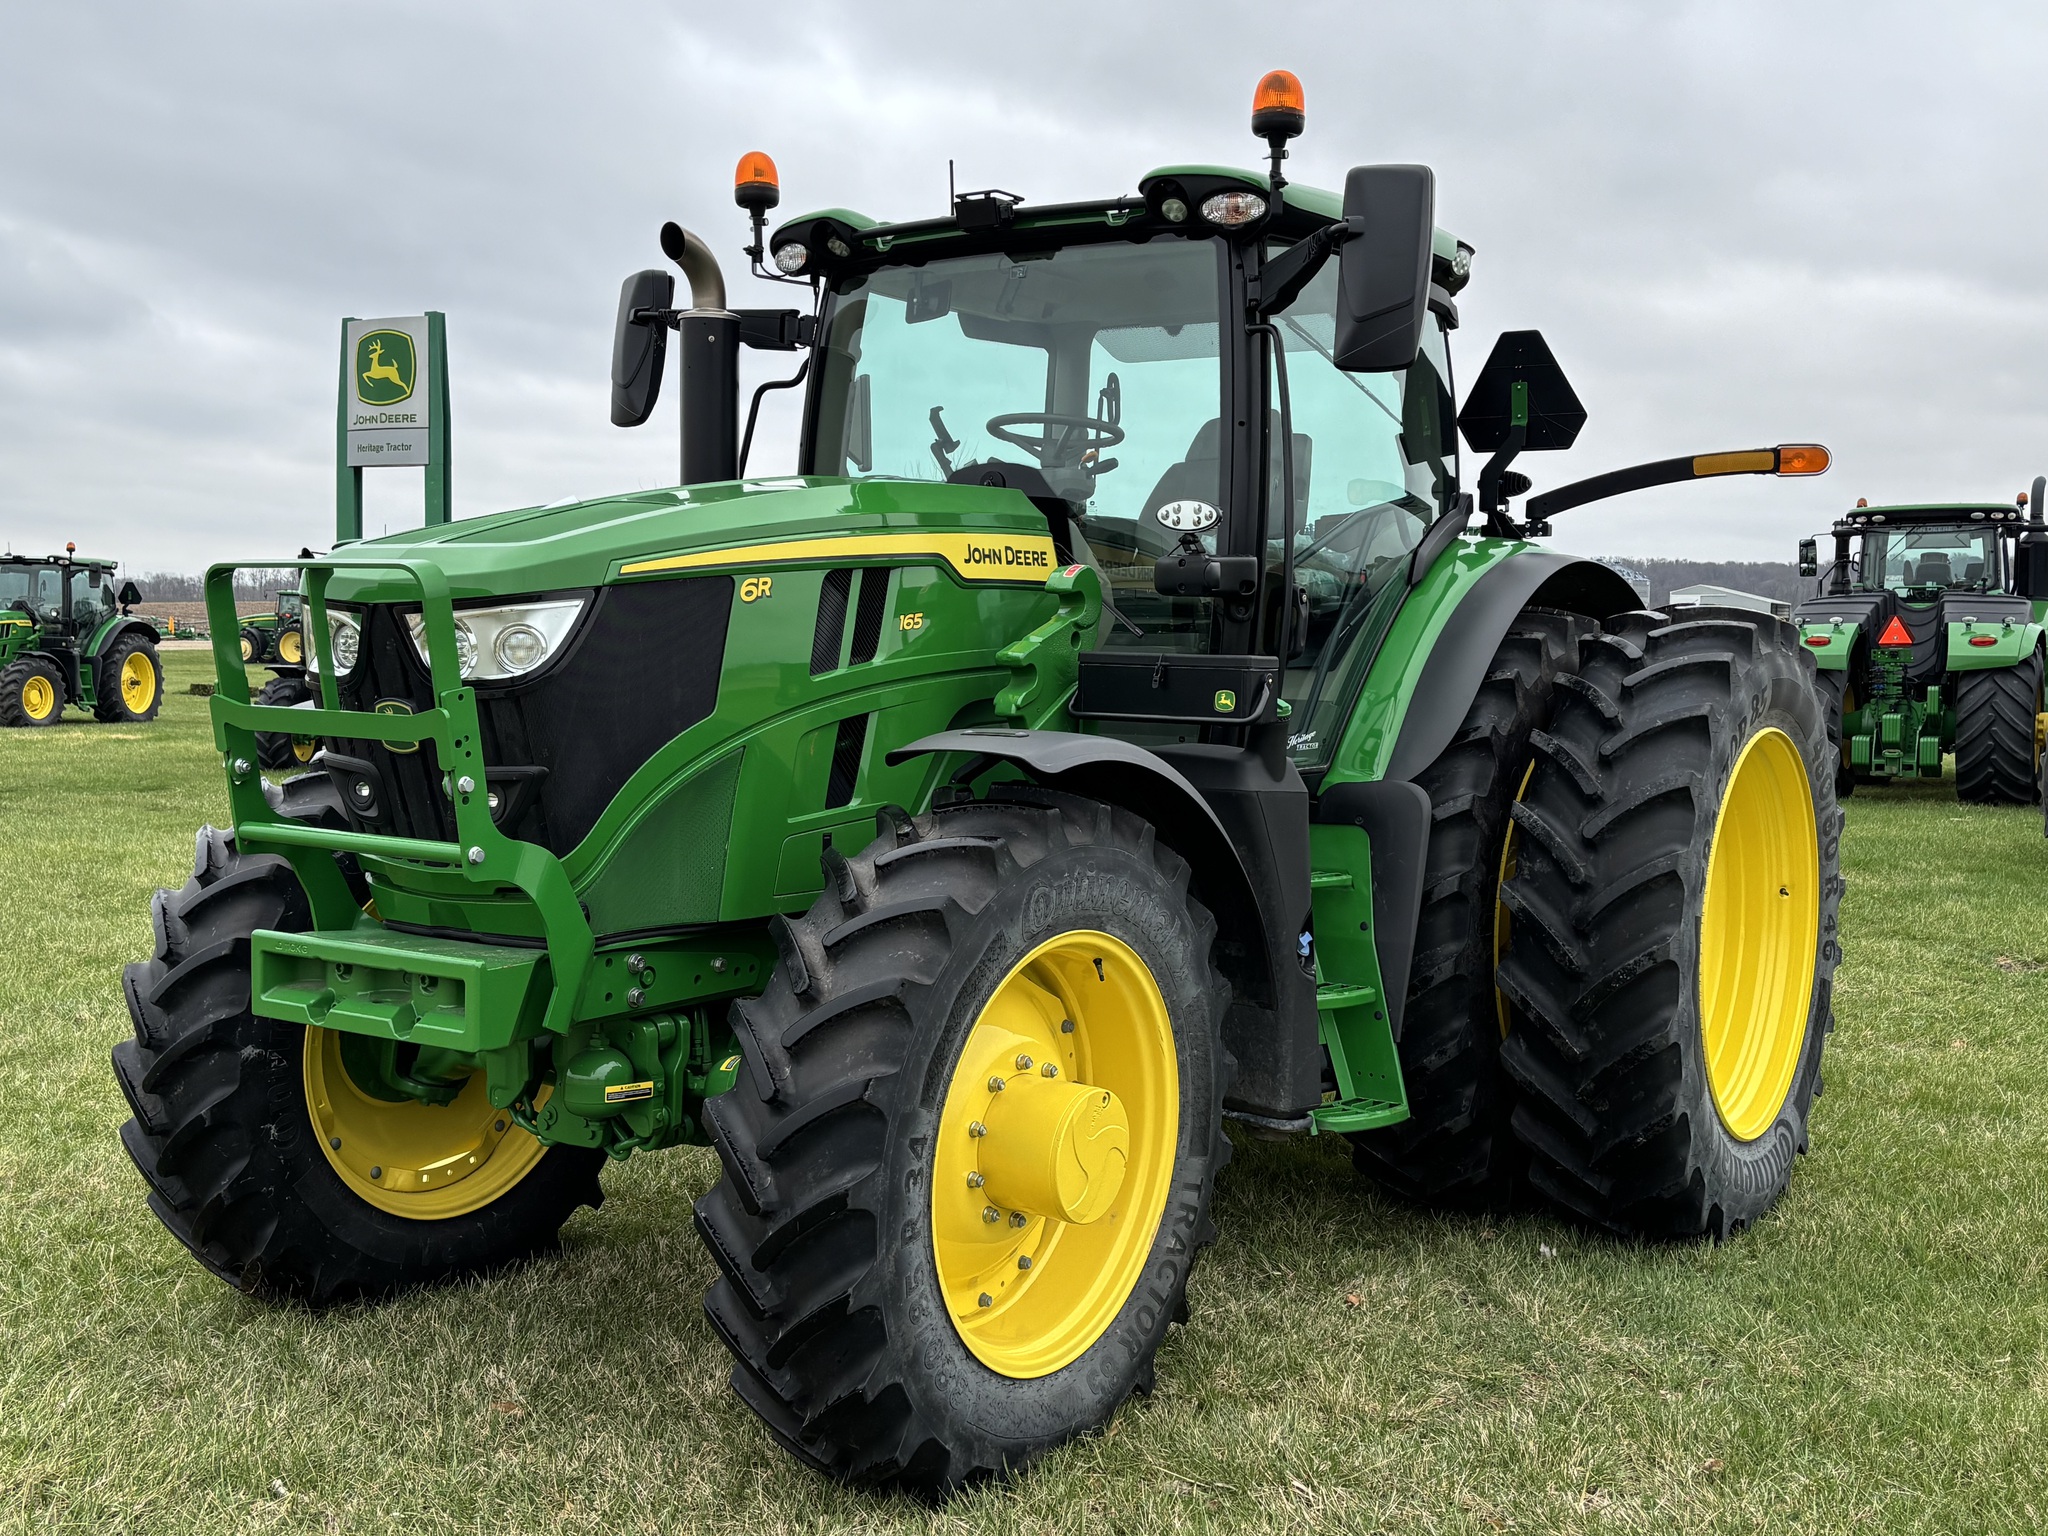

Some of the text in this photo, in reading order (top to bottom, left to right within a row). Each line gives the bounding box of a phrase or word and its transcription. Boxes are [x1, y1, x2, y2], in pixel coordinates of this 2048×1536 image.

[353, 412, 417, 426] JOHN DEERE
[357, 442, 412, 454] Heritage Tractor
[963, 543, 1048, 567] JOHN DEERE
[740, 577, 772, 603] 6R
[899, 612, 923, 631] 165
[1825, 873, 1838, 901] R
[1822, 914, 1835, 962] 46
[904, 1136, 928, 1196] 34
[901, 1211, 922, 1247] R
[1118, 1177, 1204, 1361] TRACTOR
